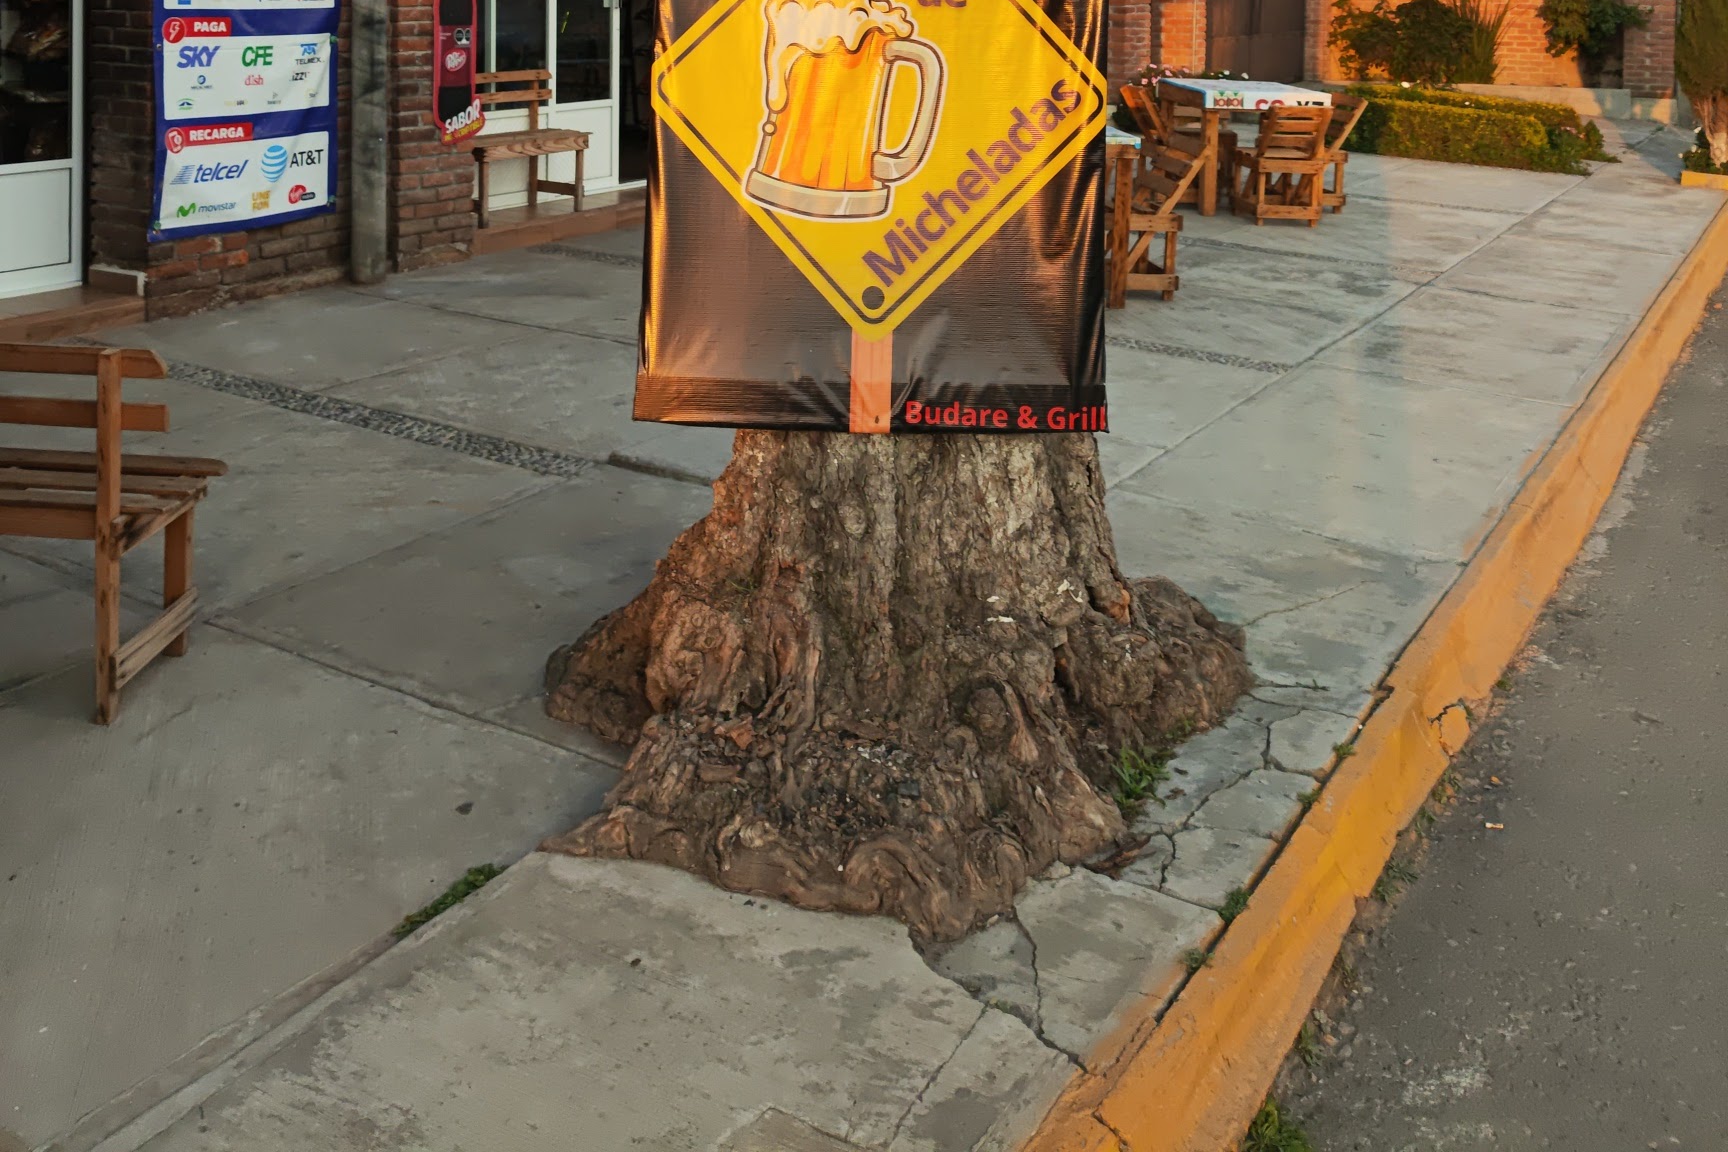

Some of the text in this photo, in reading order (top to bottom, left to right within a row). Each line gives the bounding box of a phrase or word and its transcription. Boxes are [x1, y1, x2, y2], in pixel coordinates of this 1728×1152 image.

[194, 22, 226, 33] PAGA
[177, 46, 221, 69] SKY
[241, 46, 273, 67] CFE
[295, 57, 322, 65] TELMEX
[245, 75, 264, 86] dish
[446, 98, 481, 134] SABOR
[189, 127, 244, 141] RECARGA
[290, 149, 324, 168] AT&T
[194, 160, 249, 184] telcel
[861, 78, 1083, 289] Micheladas
[198, 202, 237, 213] movistar
[905, 400, 1106, 430] Budare & Grill
